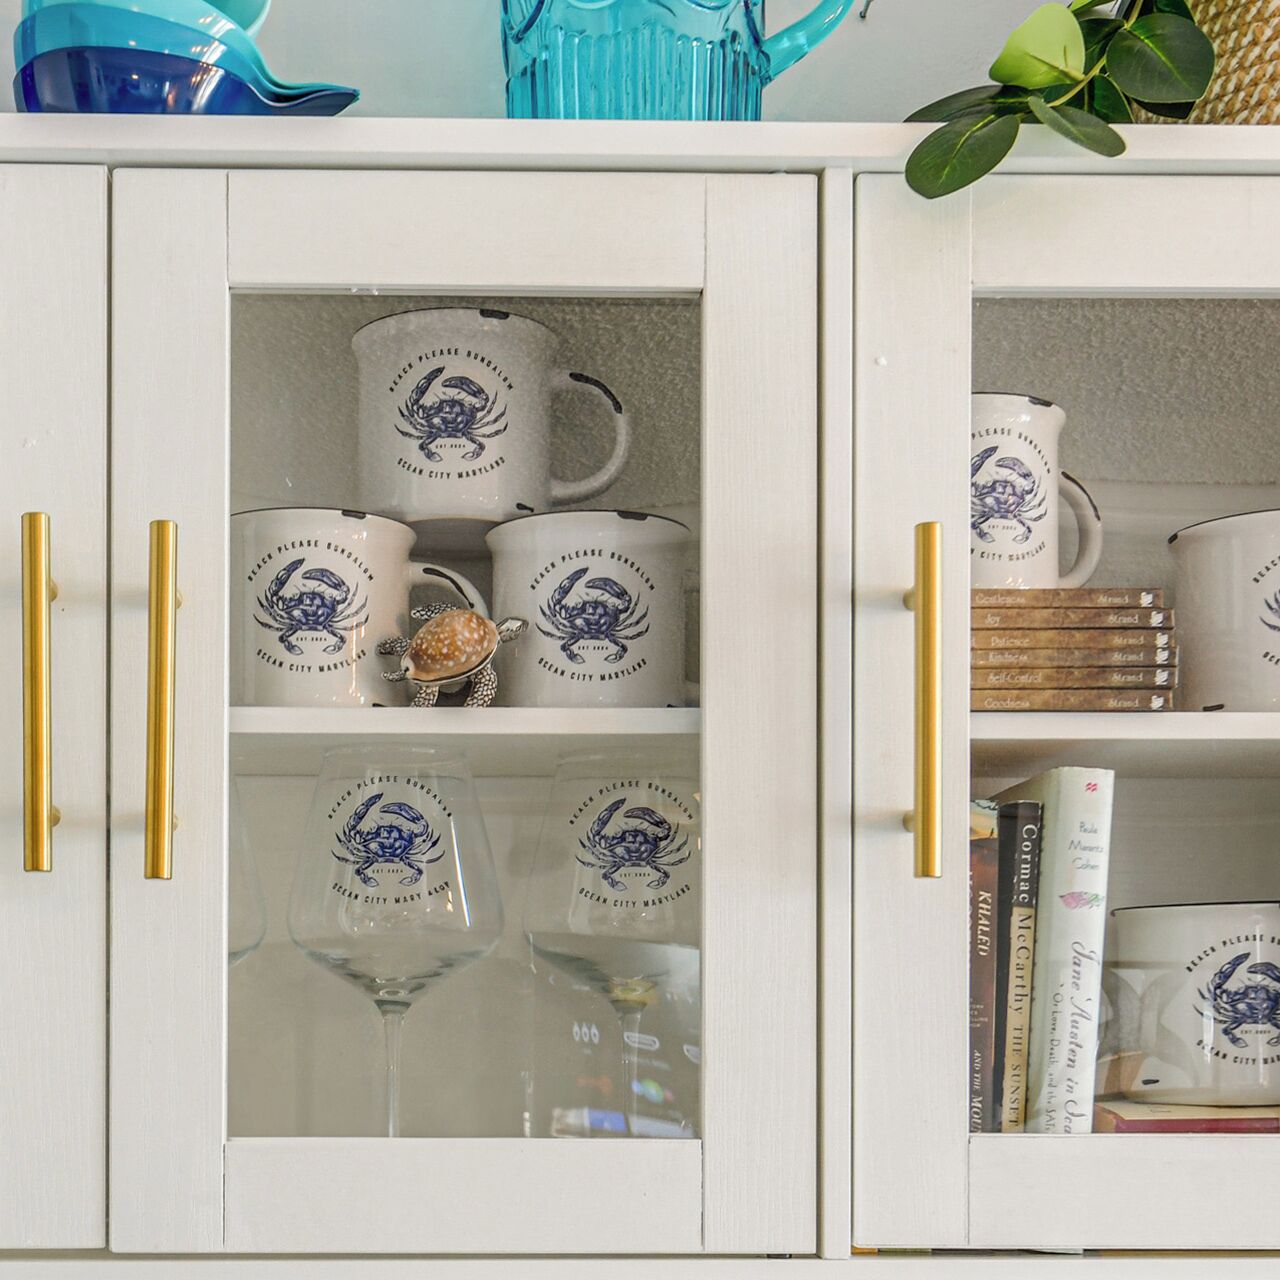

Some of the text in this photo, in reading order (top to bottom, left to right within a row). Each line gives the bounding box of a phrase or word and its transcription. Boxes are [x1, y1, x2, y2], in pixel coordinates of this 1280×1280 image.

[419, 348, 458, 362] PLEASE
[467, 350, 513, 390] BUNGALOW
[398, 457, 505, 479] OCEAN CITY MARYLAND
[248, 540, 374, 582] BEACH PLEASE BUNGALOW
[981, 551, 1002, 560] CITY
[562, 549, 602, 562] PLEASE
[611, 552, 655, 590] BUNGALOW
[985, 614, 1001, 626] Joy
[991, 636, 1030, 647] Patience
[257, 649, 311, 672] OCEAN CITY
[539, 658, 647, 681] OCEAN CITY MARYLAND
[988, 673, 1041, 683] Self-Control
[357, 776, 398, 789] PLEASE
[599, 781, 639, 795] PLEASE
[648, 783, 693, 820] BUNGALOW
[1079, 821, 1098, 834] Paula
[1072, 857, 1100, 871] Cohen
[333, 883, 387, 904] OCEAN CITY
[579, 884, 690, 908] OCEAN CITY MARYLAND
[977, 890, 992, 956] KHALED
[1186, 946, 1216, 972] BEACH
[1222, 934, 1263, 947] PLEASE
[1009, 823, 1038, 1126] Cormac McCarthy THE SUNSET
[1065, 941, 1101, 1094] Jane Austen in
[1233, 1056, 1256, 1064] CITY
